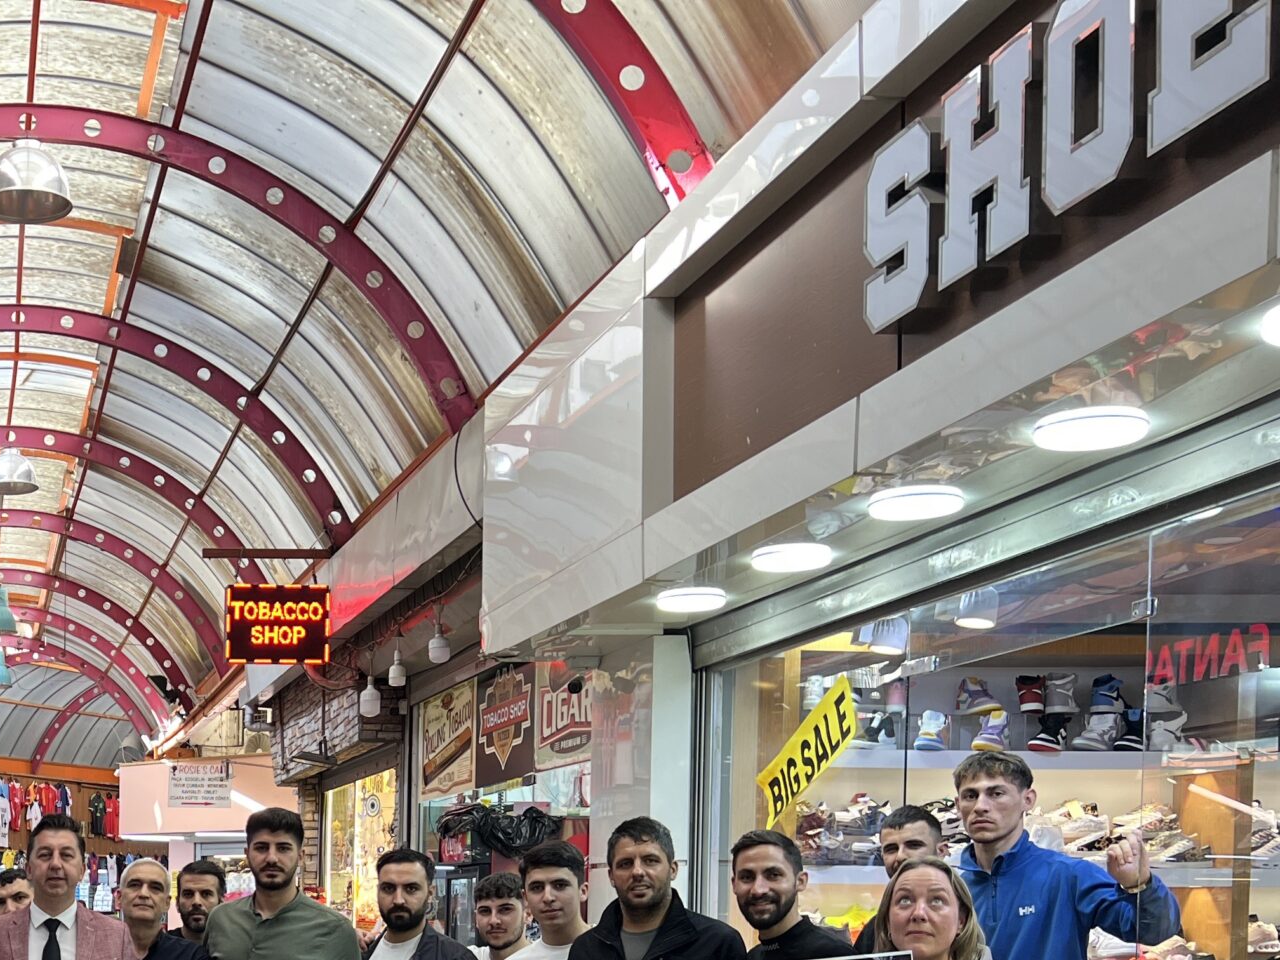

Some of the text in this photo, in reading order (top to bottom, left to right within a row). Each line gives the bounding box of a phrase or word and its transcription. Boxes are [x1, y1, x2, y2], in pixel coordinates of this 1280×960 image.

[231, 601, 323, 620] TOBACCO
[251, 625, 306, 645] SHOP
[483, 699, 526, 728] TOBACCO SHOP
[768, 691, 851, 820] BIG SALE
